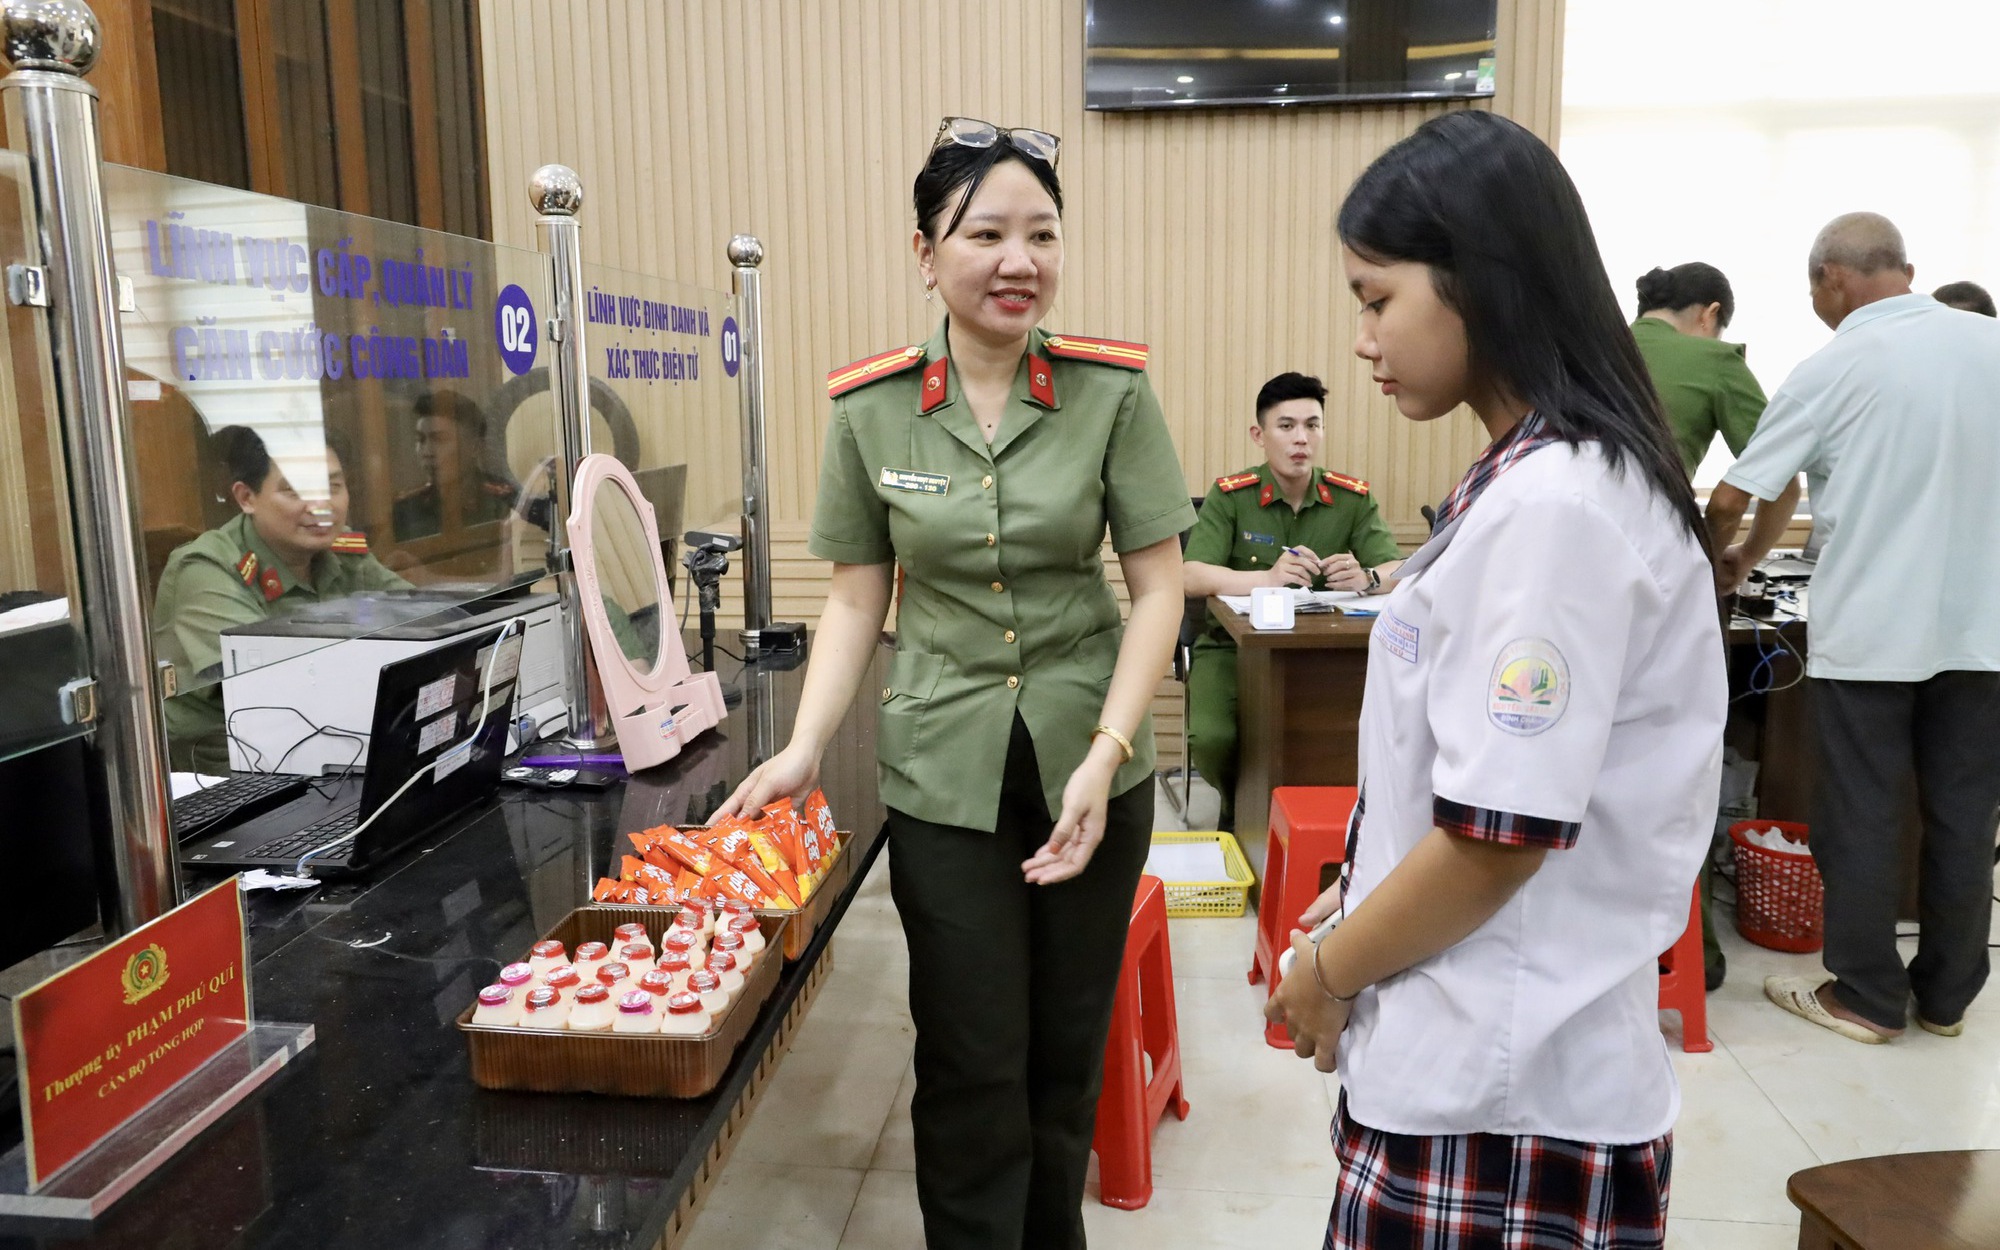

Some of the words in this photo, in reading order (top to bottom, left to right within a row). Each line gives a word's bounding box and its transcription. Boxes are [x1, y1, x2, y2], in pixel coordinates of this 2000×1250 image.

[145, 211, 237, 286] LĨNH
[243, 236, 309, 302] VỰC
[451, 261, 474, 310] LÝ
[501, 304, 532, 353] 02
[587, 285, 616, 325] LĨNH
[618, 295, 641, 333] VỰC
[644, 300, 669, 336] ĐỊNH
[671, 305, 697, 335] DANH
[698, 306, 710, 337] VÀ
[174, 316, 252, 381] CĂN
[261, 322, 343, 381] CƯỚC
[351, 325, 420, 379] CÔNG
[424, 329, 469, 378] DÂN
[606, 342, 630, 379] XÁC
[632, 348, 660, 386] THỰC
[662, 347, 685, 386] ĐIỆN
[686, 346, 699, 381] TỬ
[723, 330, 737, 362] 01
[43, 1054, 103, 1102] Thượng
[126, 1005, 173, 1048] PHẠM
[177, 981, 206, 1014] PHÚ
[208, 961, 235, 993] QUÍ
[128, 1059, 146, 1079] BỘ
[182, 1017, 205, 1041] HỢP
